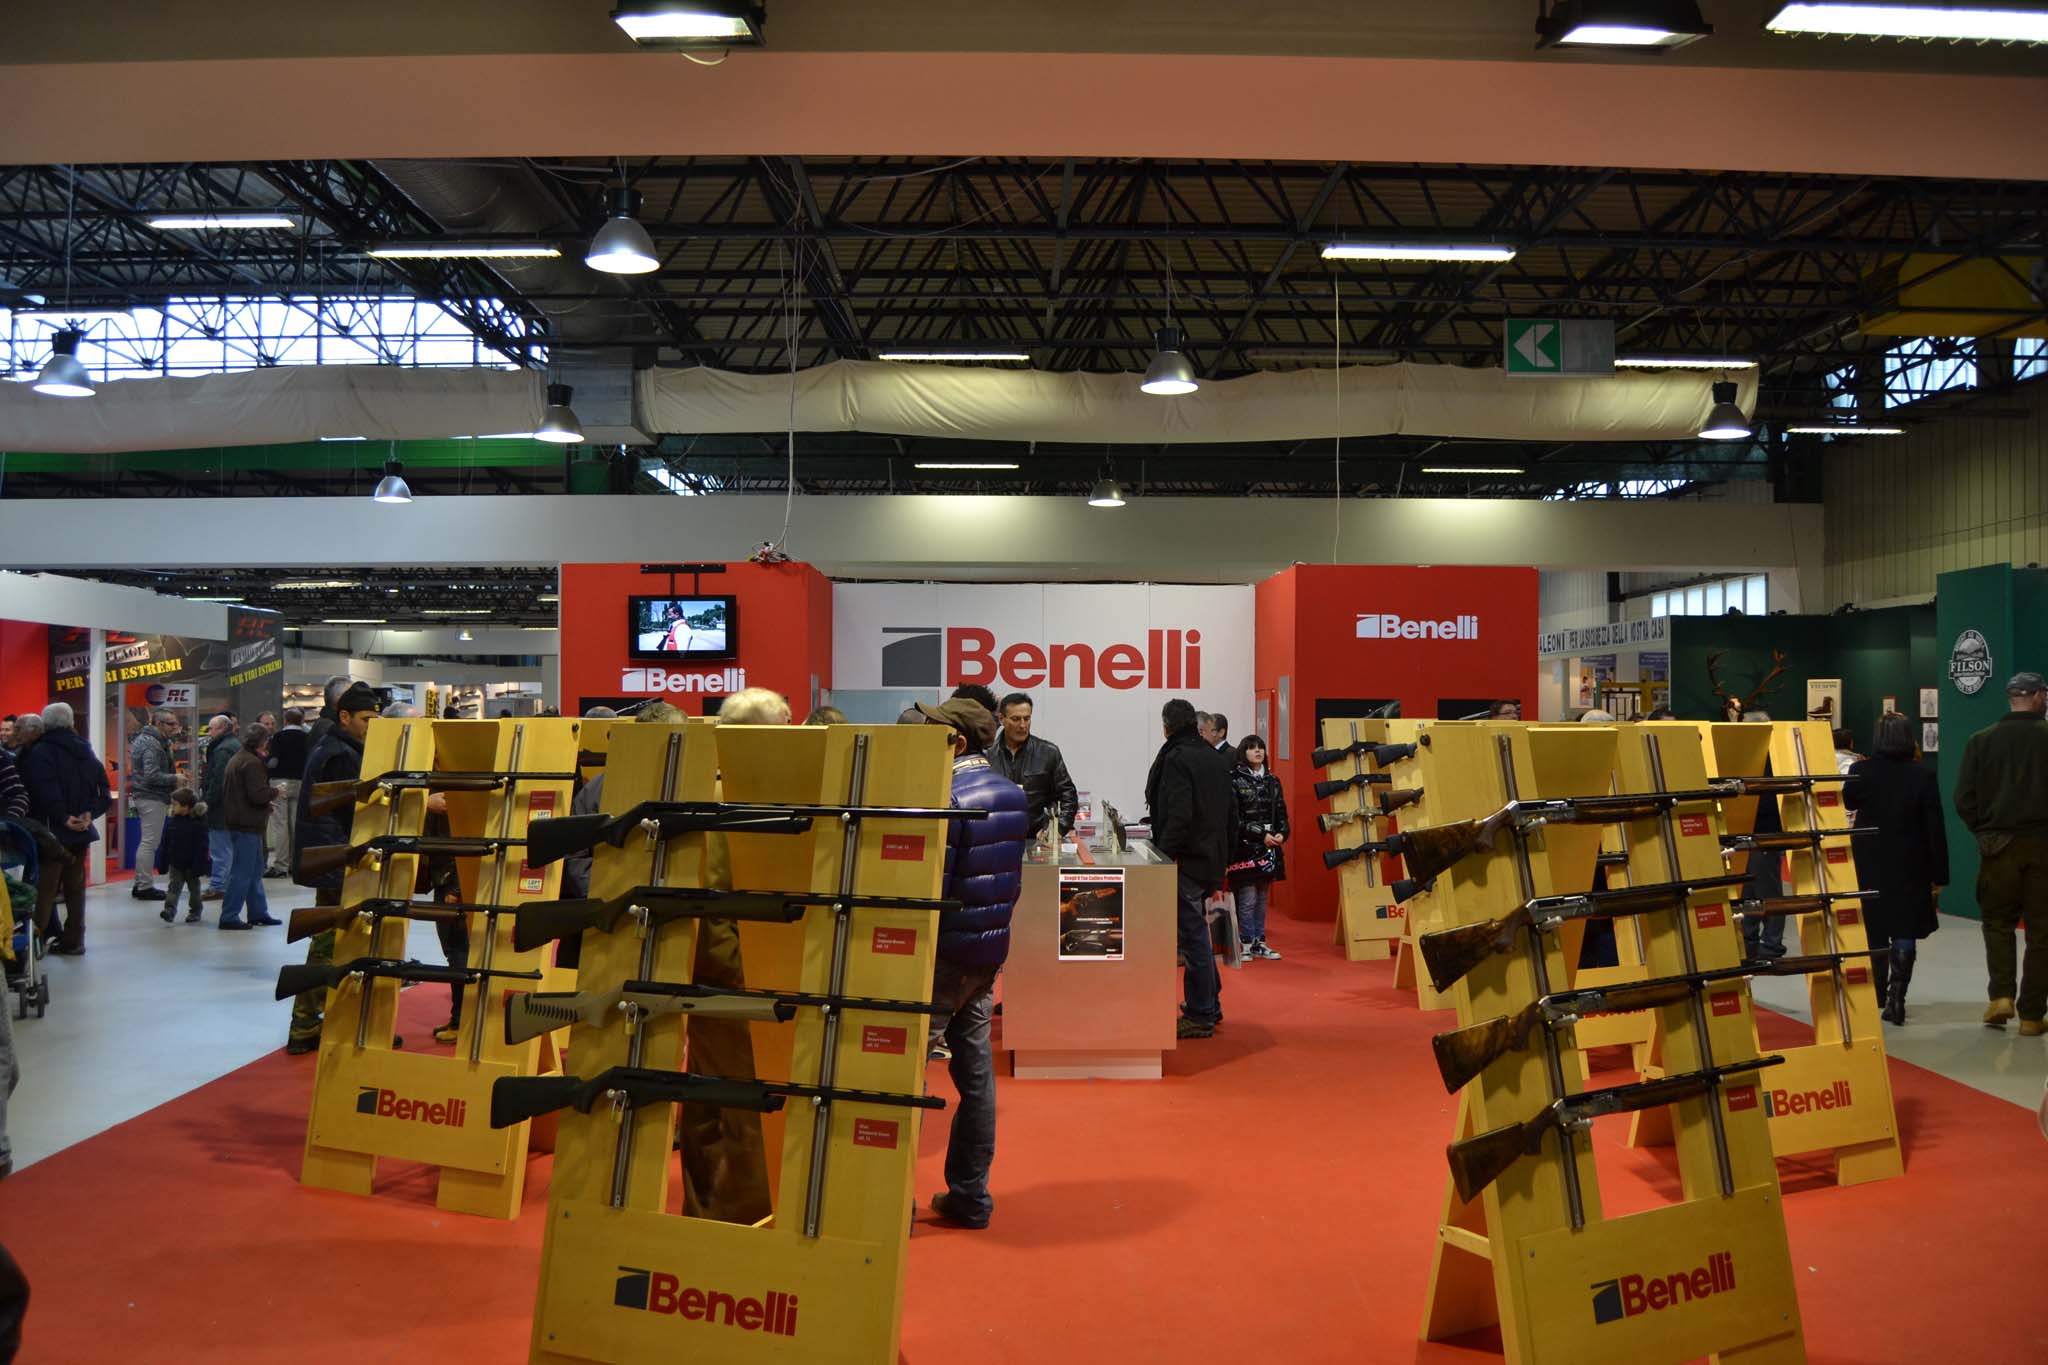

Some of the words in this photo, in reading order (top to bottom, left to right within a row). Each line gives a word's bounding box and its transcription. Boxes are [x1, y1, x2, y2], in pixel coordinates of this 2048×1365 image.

[1381, 614, 1478, 640] Benelli
[60, 645, 146, 669] CAMFLAGE
[230, 673, 244, 687] PER
[258, 658, 282, 677] ESTREMI
[947, 627, 1201, 690] Benelli
[1951, 660, 1990, 673] FILSON
[55, 675, 85, 691] PER
[120, 657, 183, 680] ESTREMI
[647, 668, 745, 693] Benelli
[166, 689, 190, 702] AC
[378, 1088, 467, 1128] Benelli
[1772, 1080, 1852, 1117] Benelli
[1620, 1251, 1736, 1317] Benelli
[649, 1271, 799, 1337] Benelli
